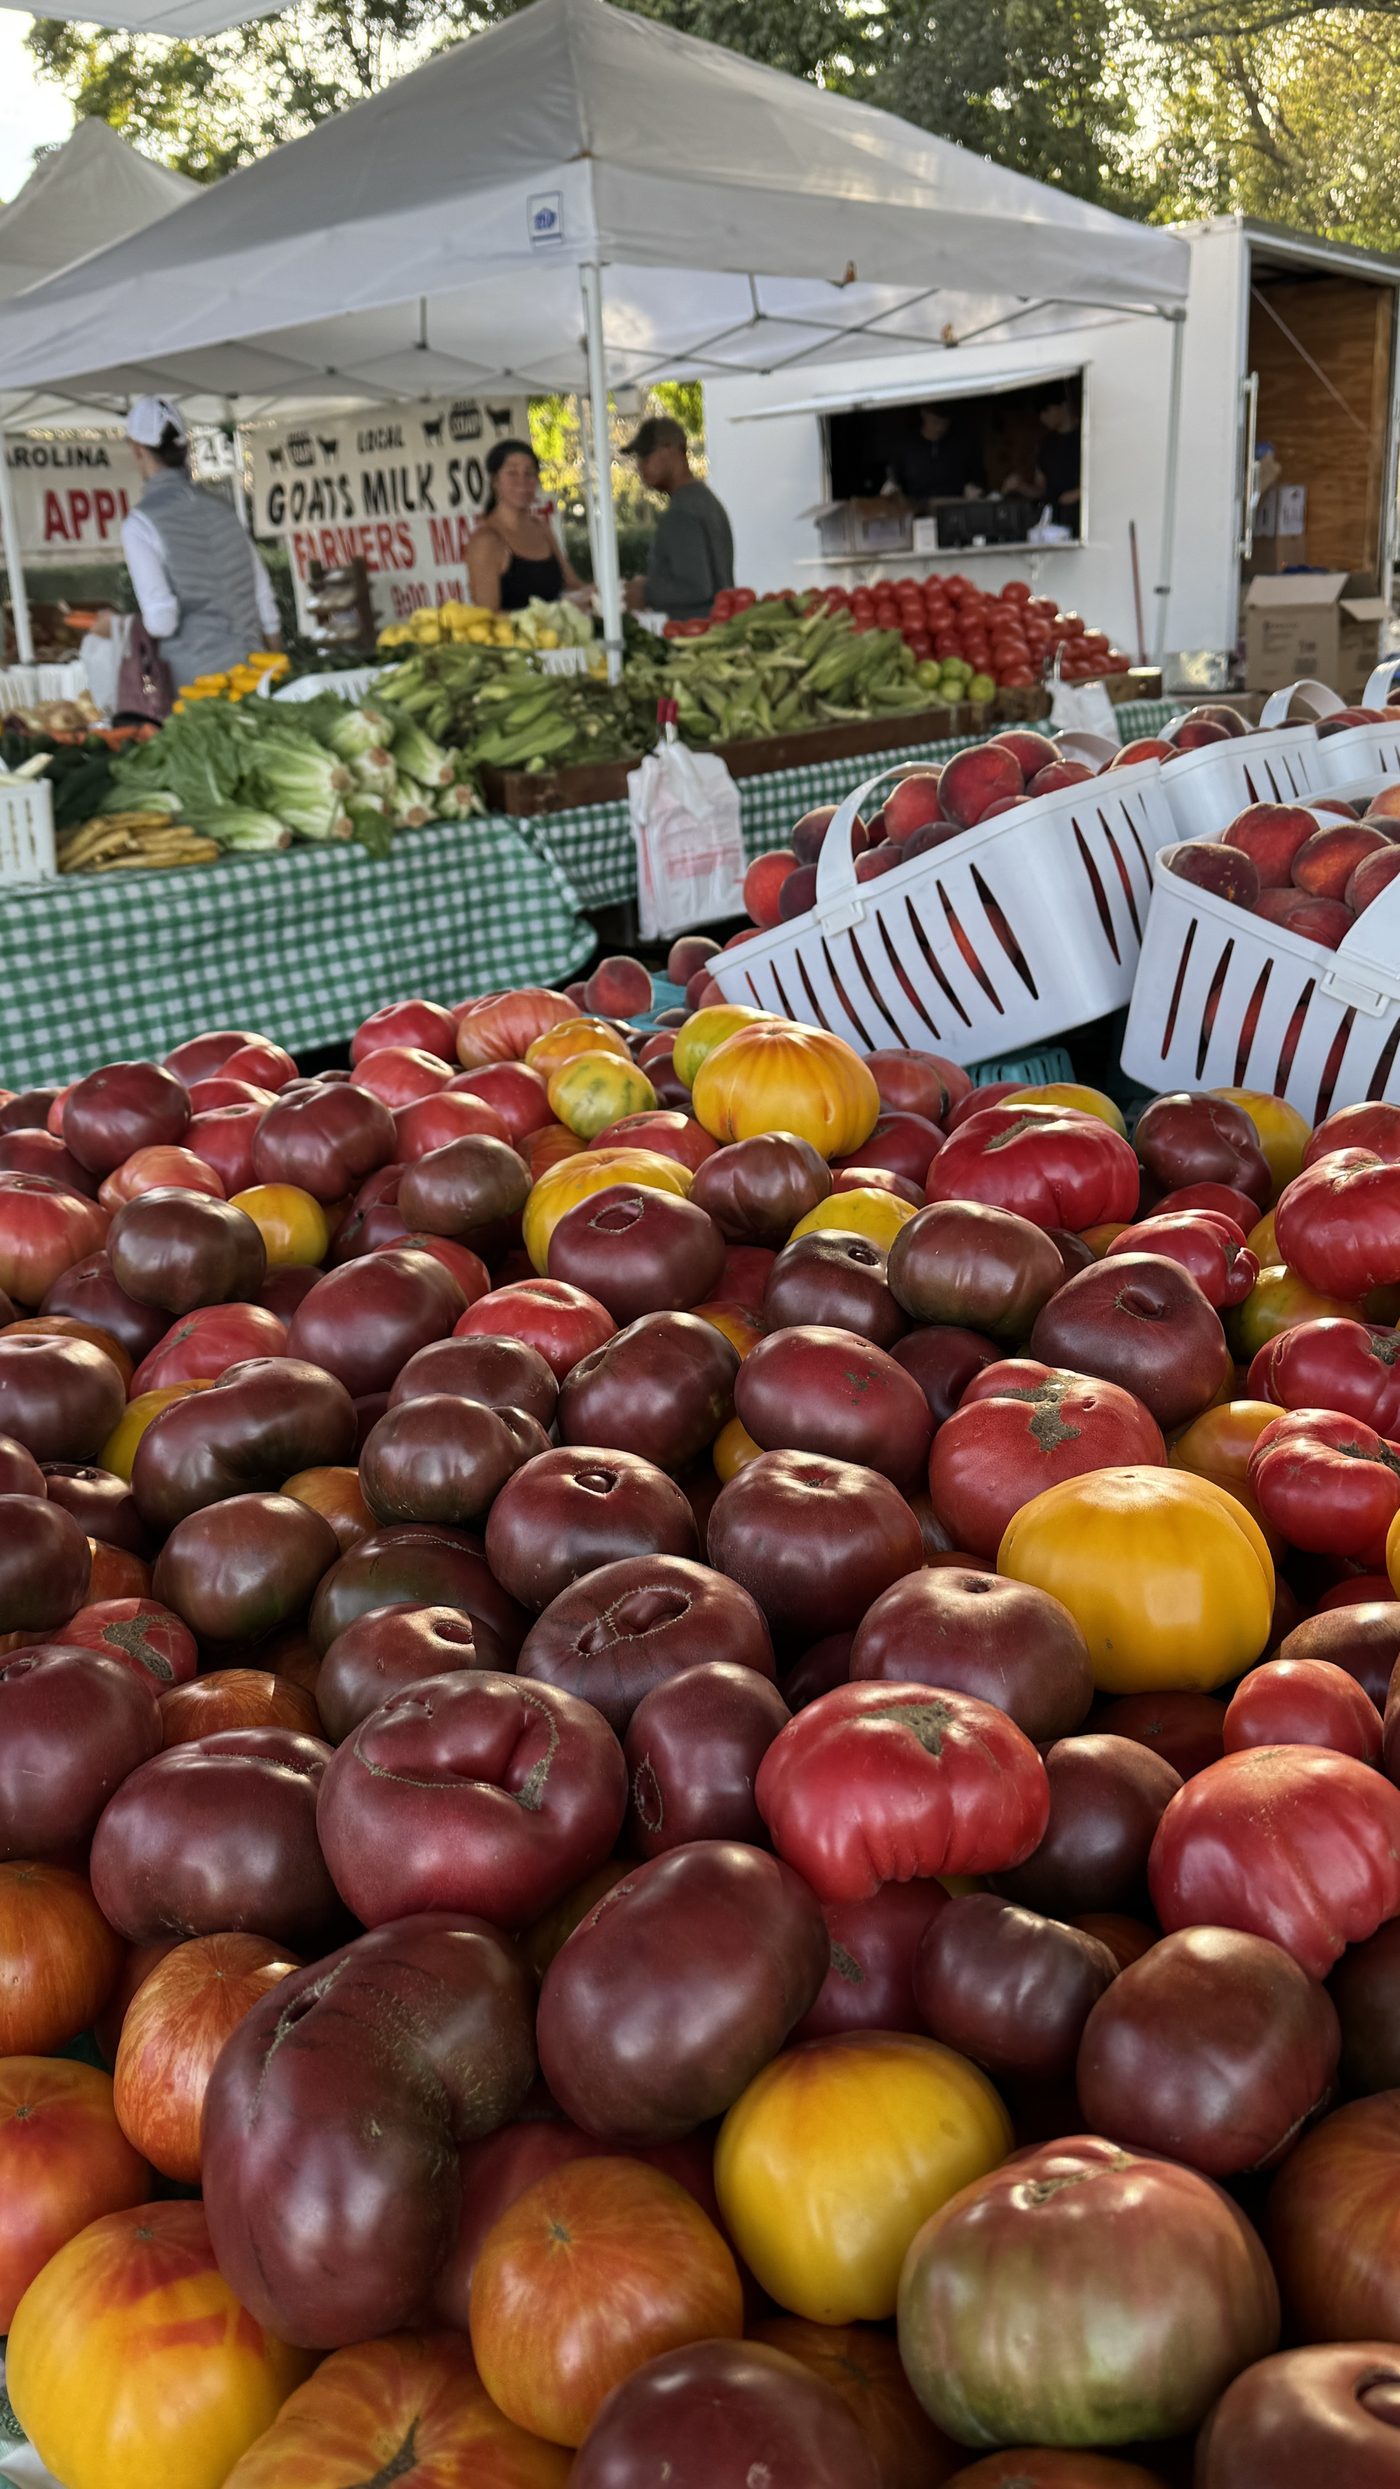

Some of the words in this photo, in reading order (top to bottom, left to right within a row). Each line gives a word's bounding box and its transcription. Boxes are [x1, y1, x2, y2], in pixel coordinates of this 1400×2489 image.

[357, 424, 404, 454] LOCAL
[268, 474, 354, 525] GOATS
[362, 465, 435, 515] MILK
[293, 520, 415, 582] FARMERS
